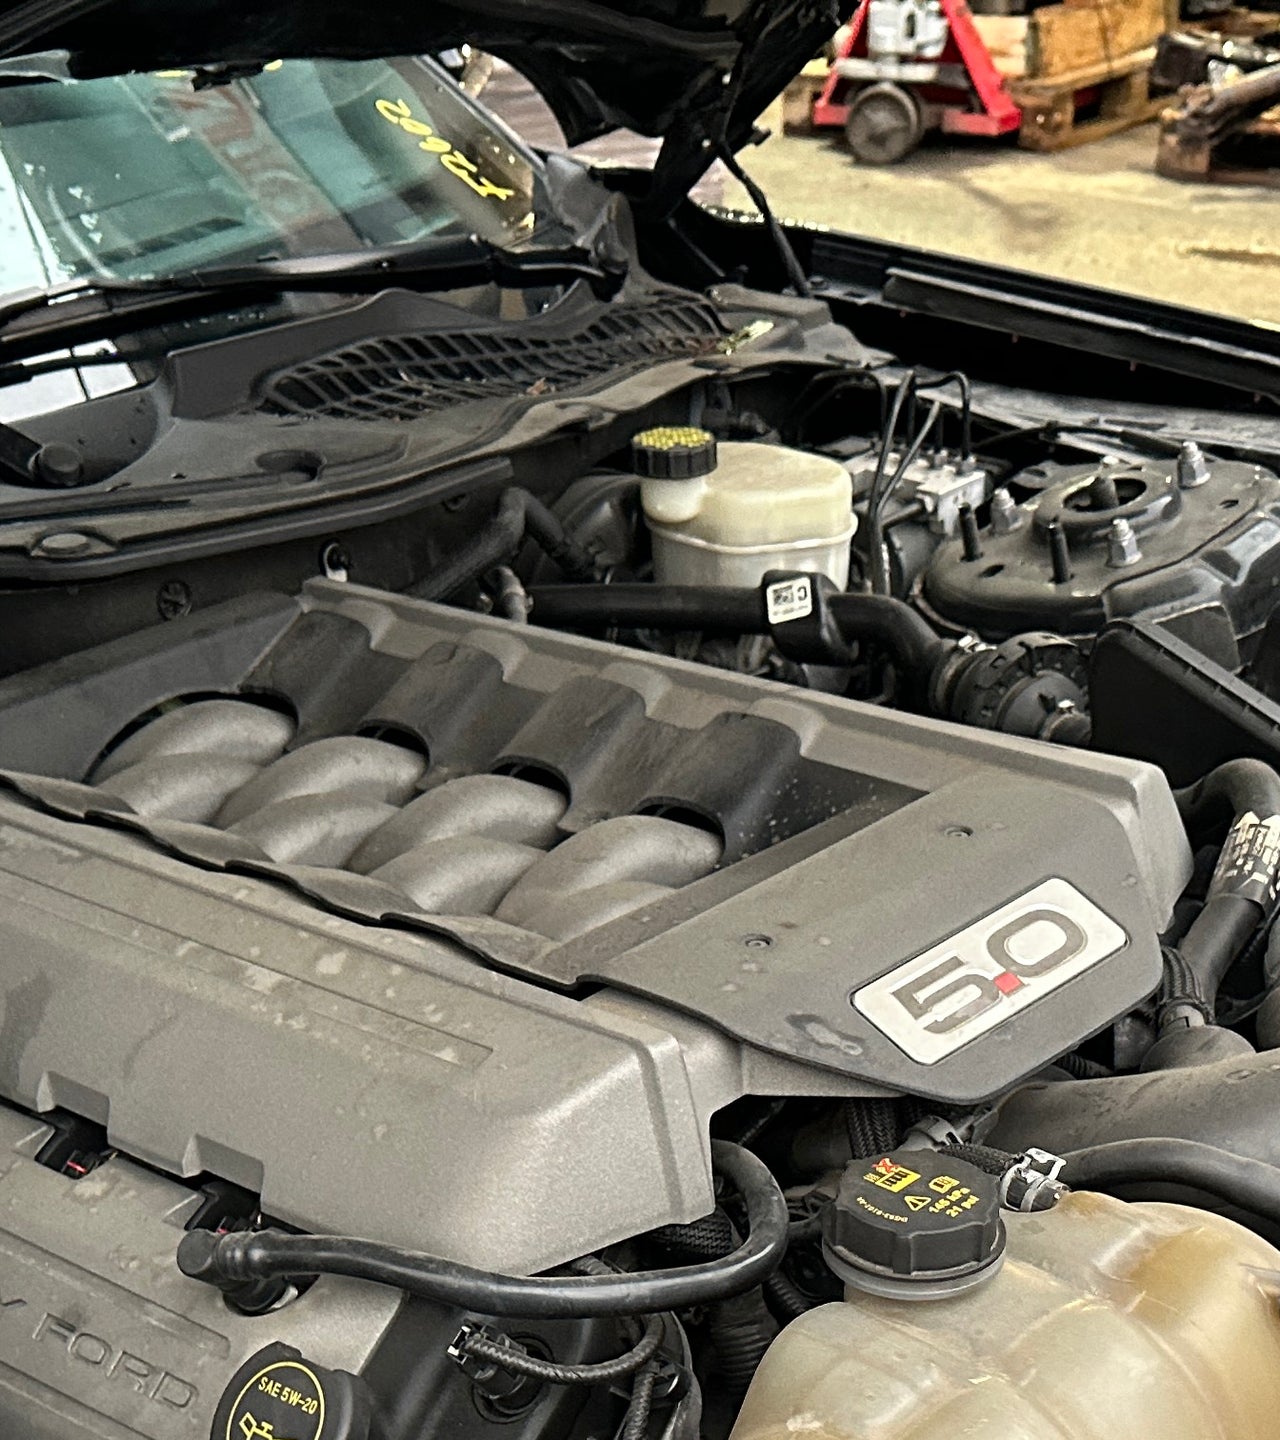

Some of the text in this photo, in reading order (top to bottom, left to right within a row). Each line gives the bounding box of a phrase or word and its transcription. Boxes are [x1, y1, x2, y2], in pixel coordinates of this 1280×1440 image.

[890, 908, 1088, 1034] 5.0
[31, 1312, 199, 1409] FORD
[258, 1376, 318, 1415] SAE 5W-20
